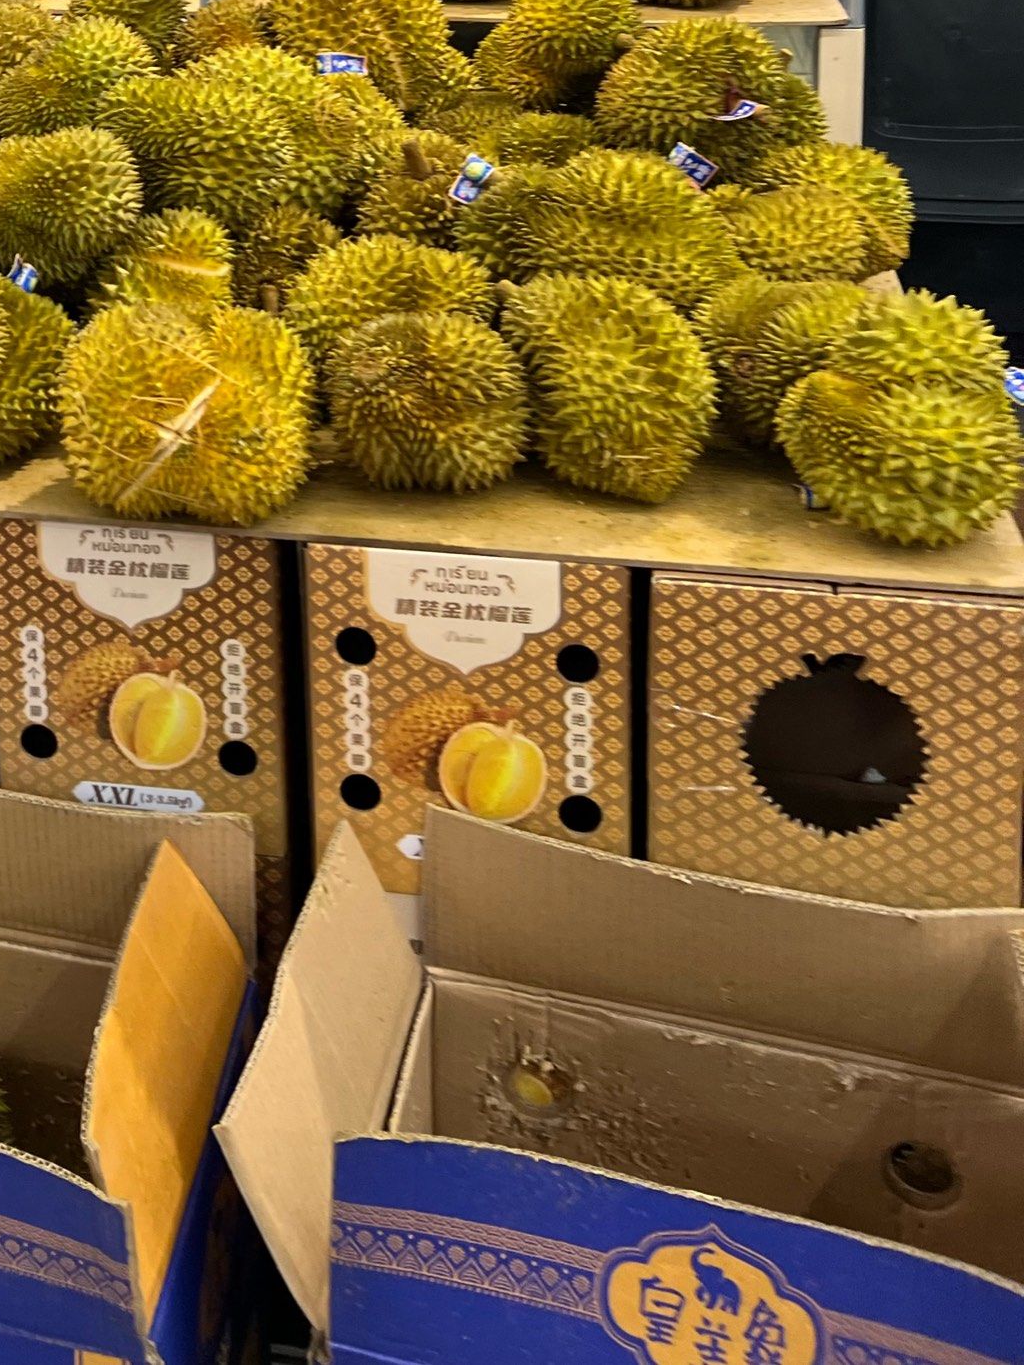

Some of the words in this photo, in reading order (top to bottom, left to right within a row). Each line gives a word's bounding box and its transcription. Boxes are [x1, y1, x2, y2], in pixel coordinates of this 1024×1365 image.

[66, 557, 190, 580] 精装金枕榴莲
[395, 598, 533, 624] 精装金枕榴莲
[88, 784, 138, 806] XXL
